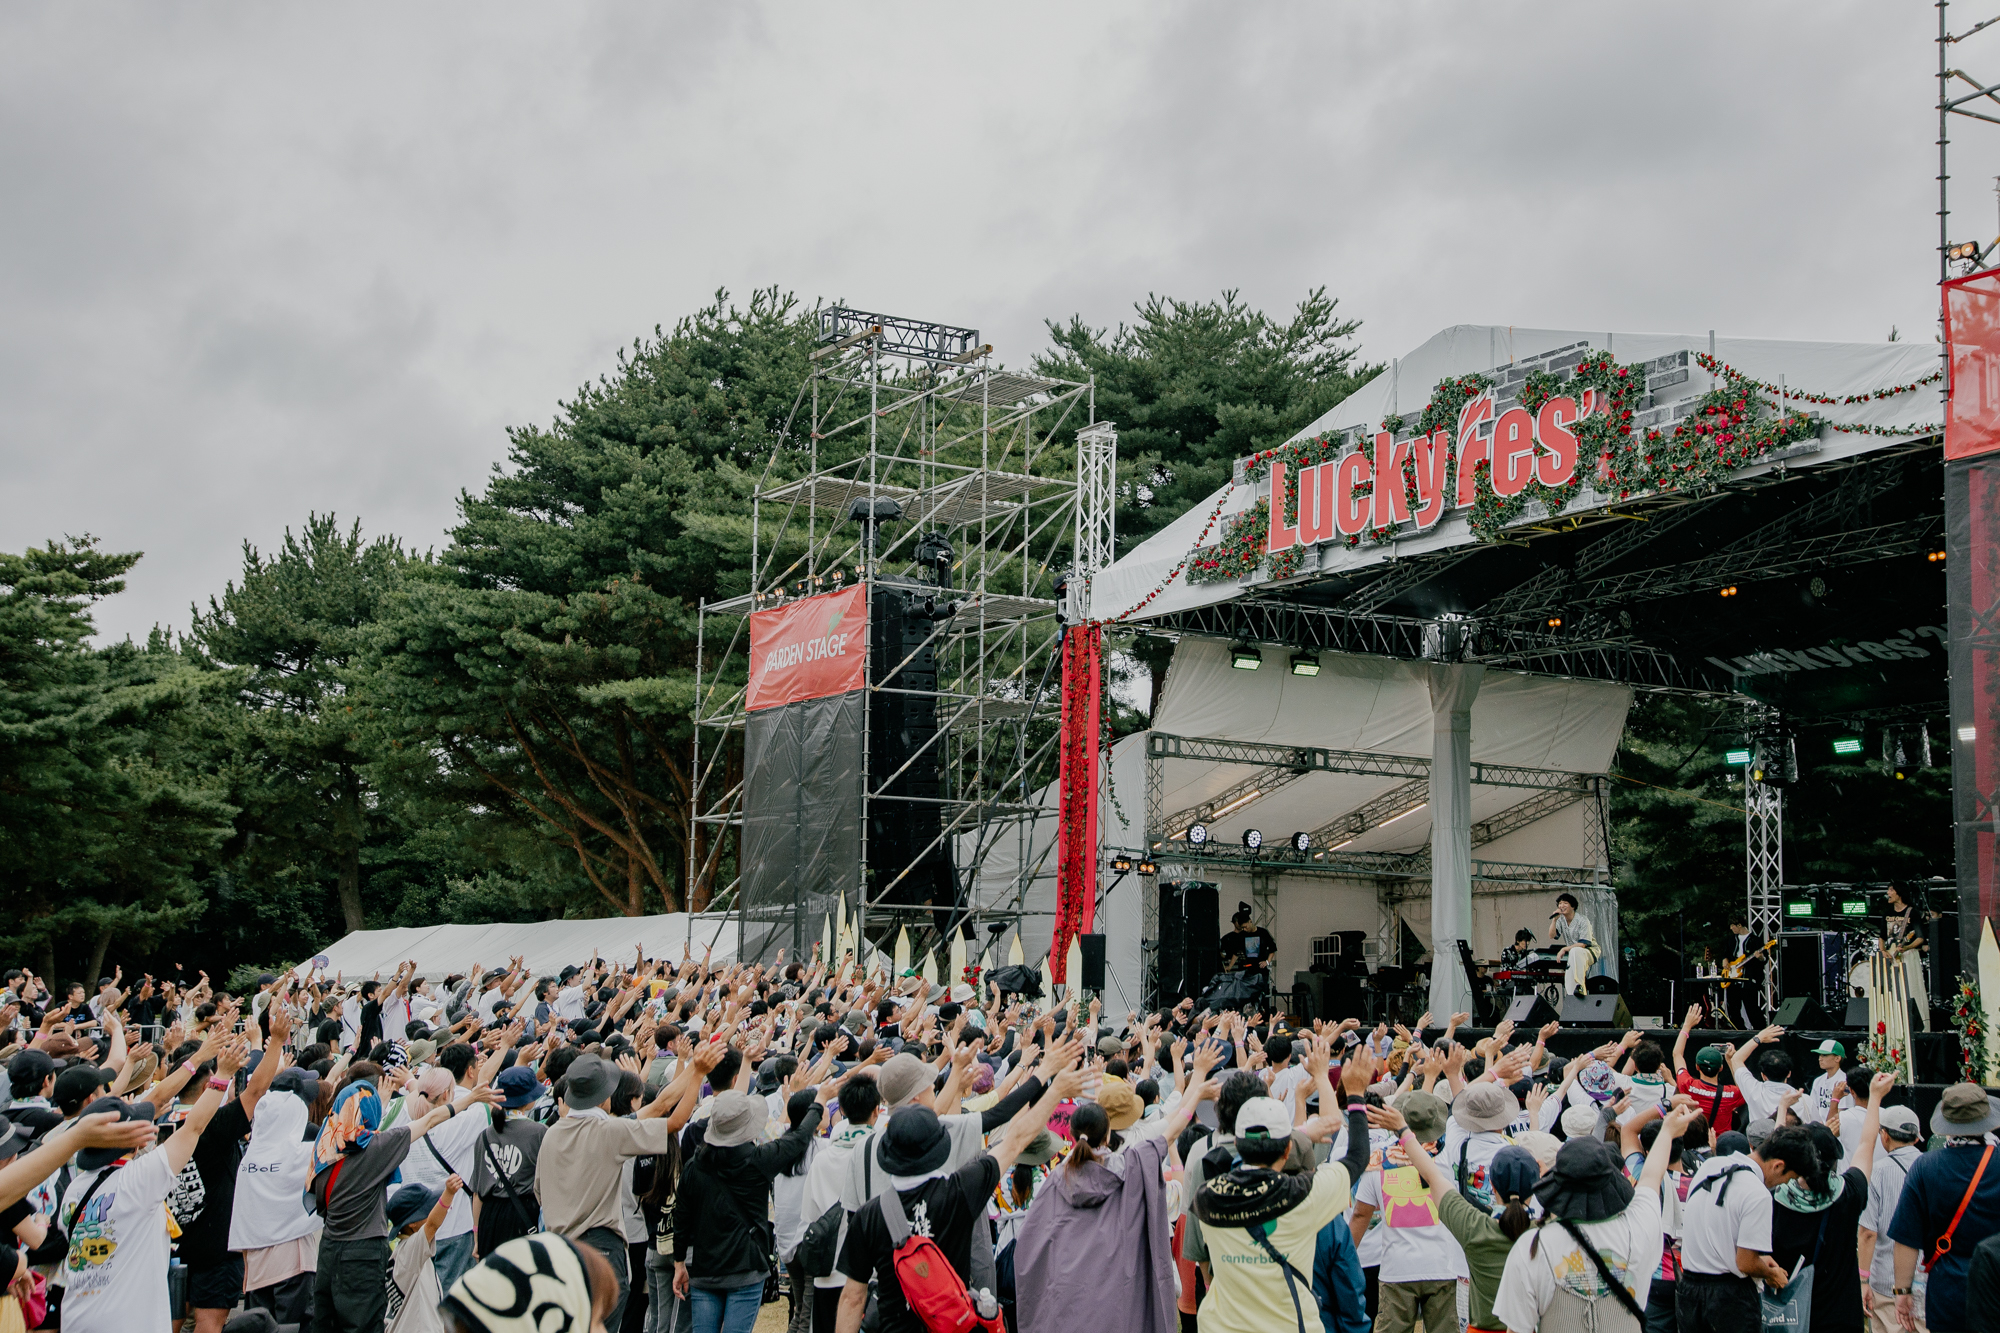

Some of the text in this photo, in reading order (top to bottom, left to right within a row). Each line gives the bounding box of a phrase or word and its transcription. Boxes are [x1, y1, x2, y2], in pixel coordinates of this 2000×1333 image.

[764, 632, 848, 674] GARDEN STAGE
[85, 1244, 109, 1257] '25
[1221, 1252, 1290, 1264] canterbuy
